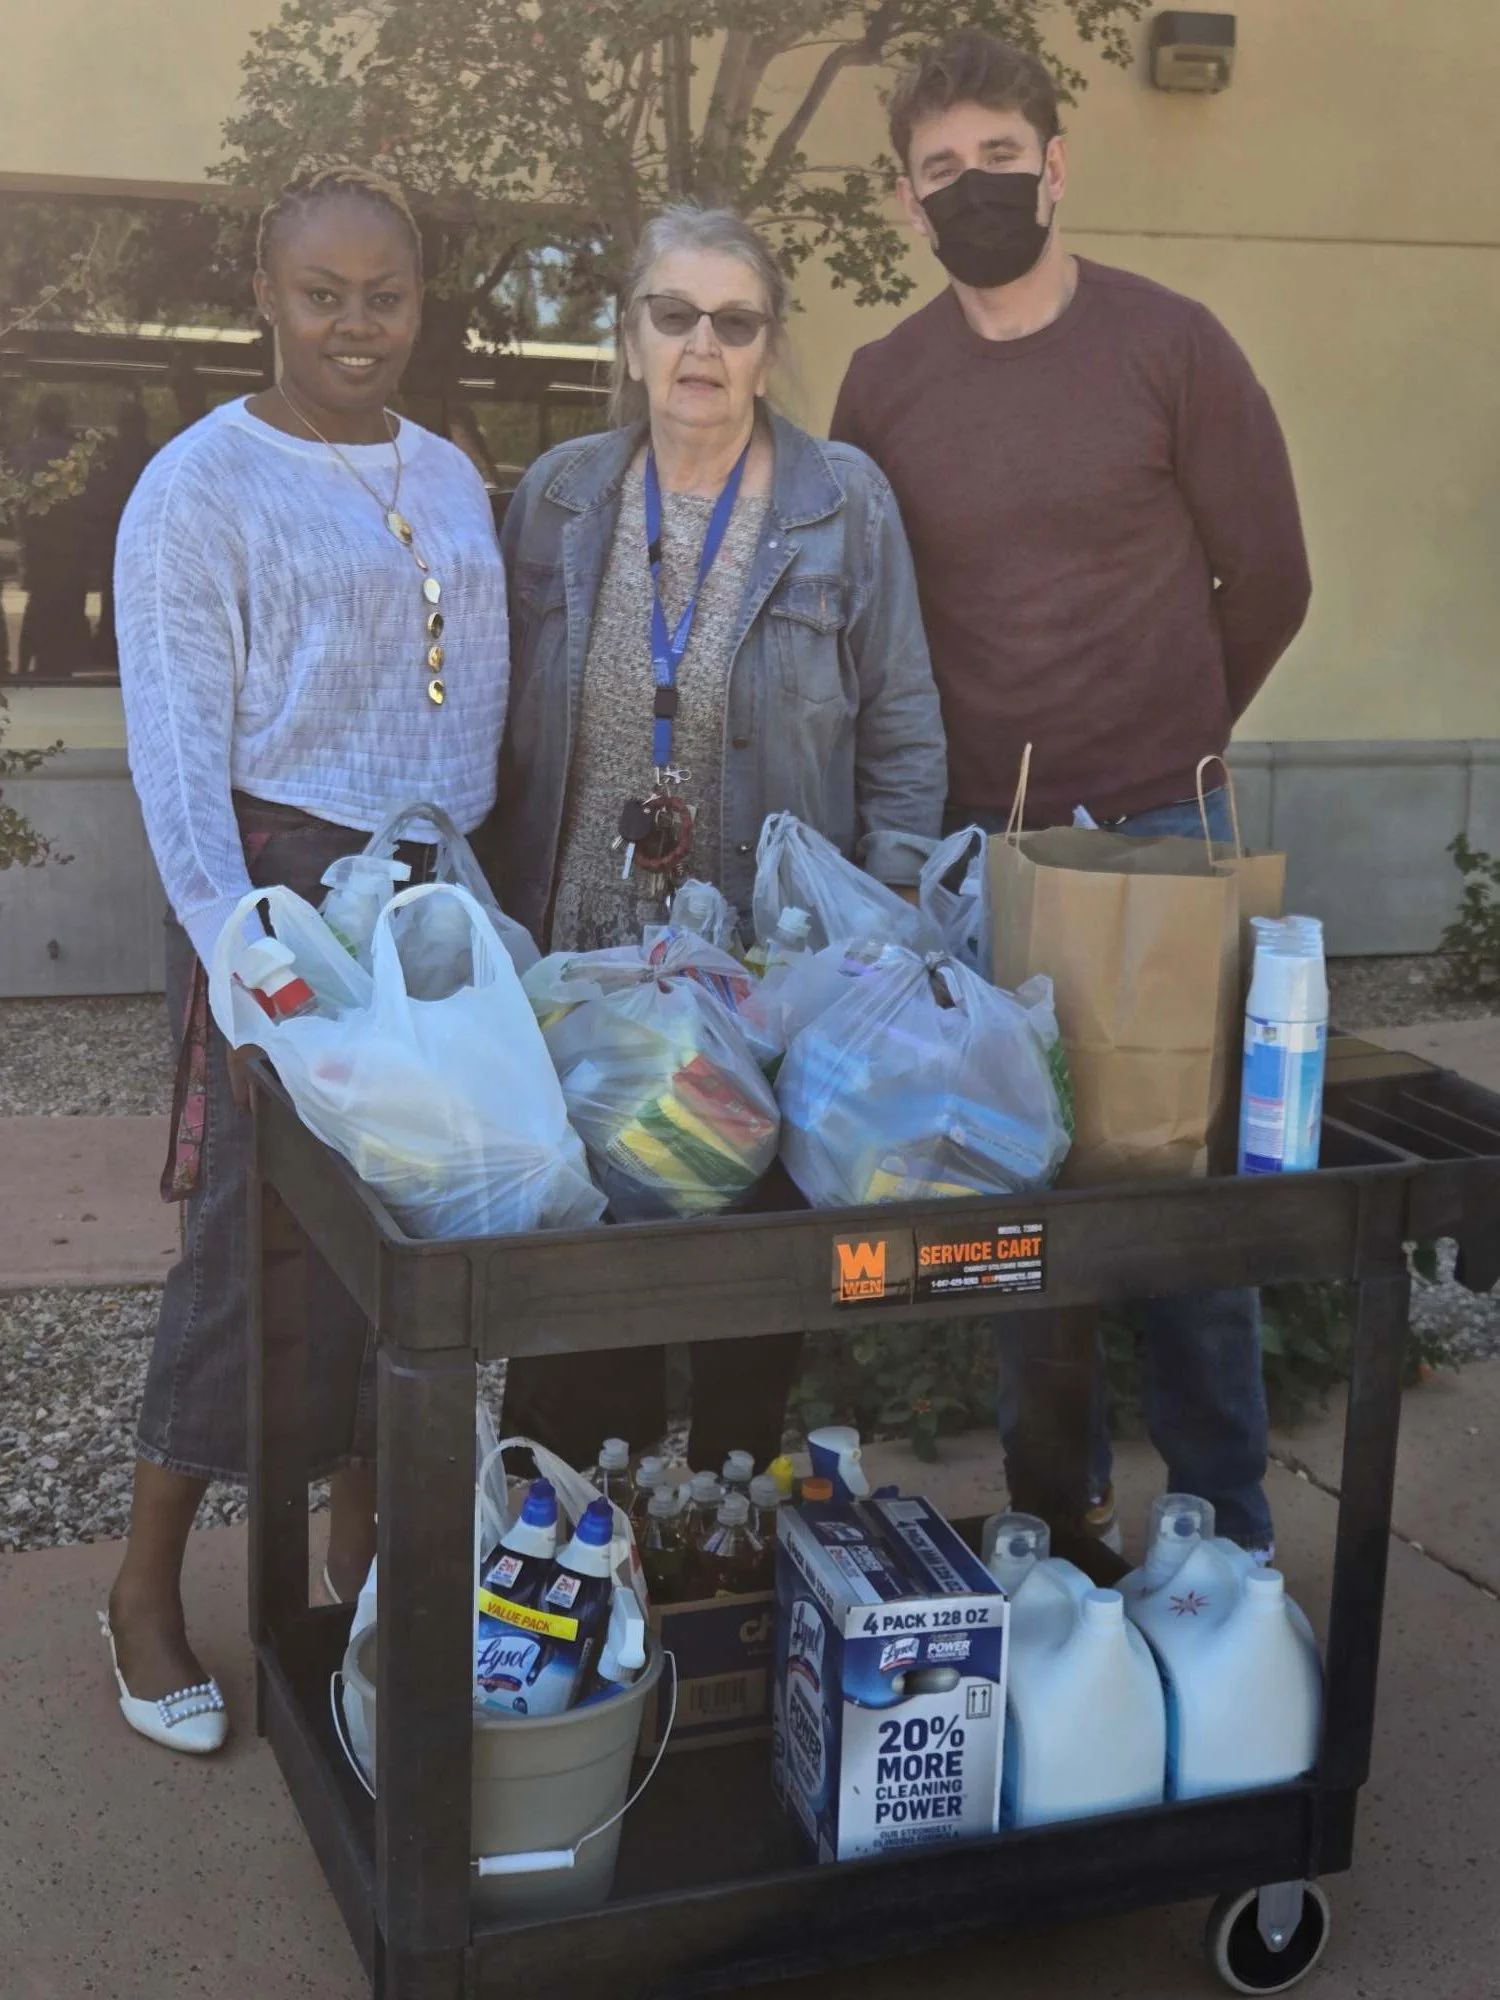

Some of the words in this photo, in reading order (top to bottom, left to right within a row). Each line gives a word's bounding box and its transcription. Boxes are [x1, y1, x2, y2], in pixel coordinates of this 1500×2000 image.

[920, 1241, 993, 1266] SERVICE
[997, 1237, 1043, 1259] CART
[844, 1280, 882, 1295] WEN
[487, 1601, 521, 1624] VALUE
[521, 1615, 550, 1633] PACK
[862, 1612, 879, 1636] 4
[883, 1613, 927, 1631] PACK
[932, 1610, 962, 1627] 128
[965, 1608, 990, 1624] OZ
[478, 1638, 537, 1676] Lysol
[927, 1639, 971, 1654] POWER
[878, 1714, 965, 1755] 20%
[877, 1750, 964, 1784] MORE
[875, 1779, 963, 1801] CLEANING
[875, 1795, 963, 1824] POWER
